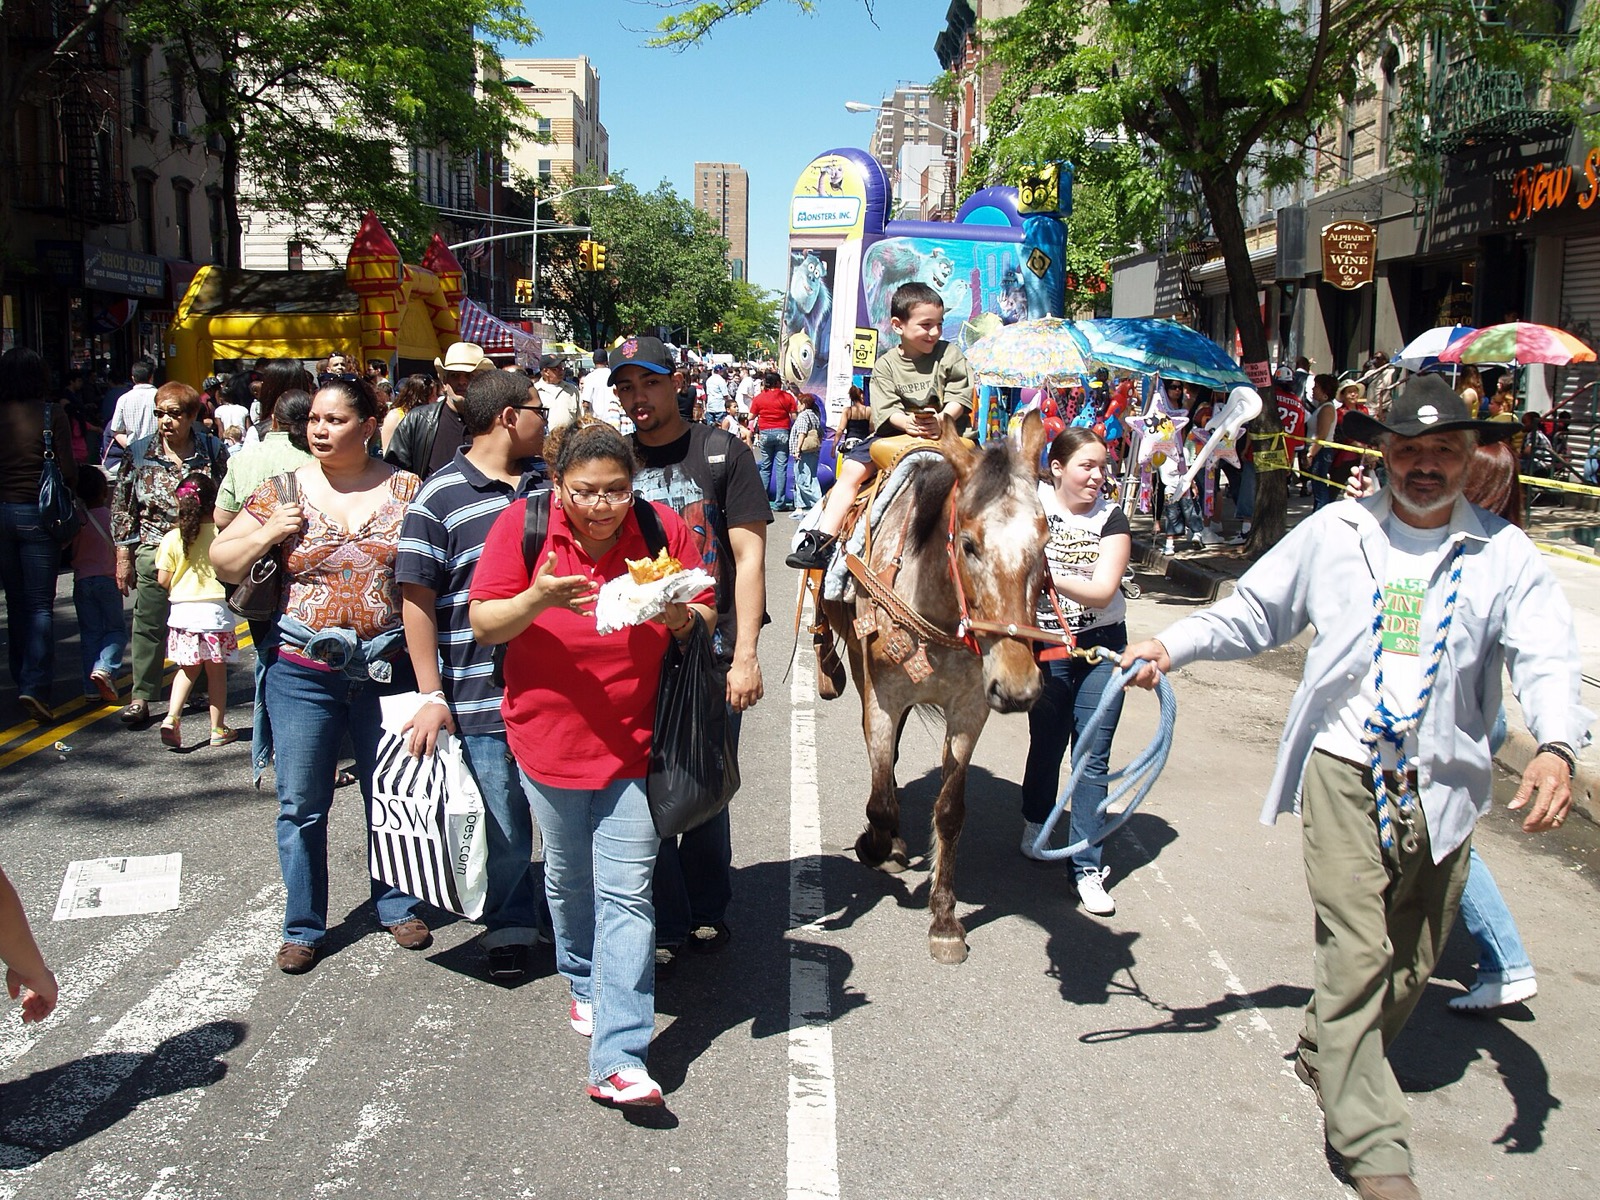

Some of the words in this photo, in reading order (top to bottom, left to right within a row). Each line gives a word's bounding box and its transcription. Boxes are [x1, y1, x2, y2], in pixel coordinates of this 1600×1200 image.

[1509, 163, 1572, 220] New
[1327, 232, 1371, 242] ALPHABET
[1338, 241, 1359, 250] CITY
[101, 252, 125, 270] SHOE
[127, 257, 160, 276] REPAIR
[1330, 254, 1368, 265] WINE
[1338, 264, 1363, 275] CO.
